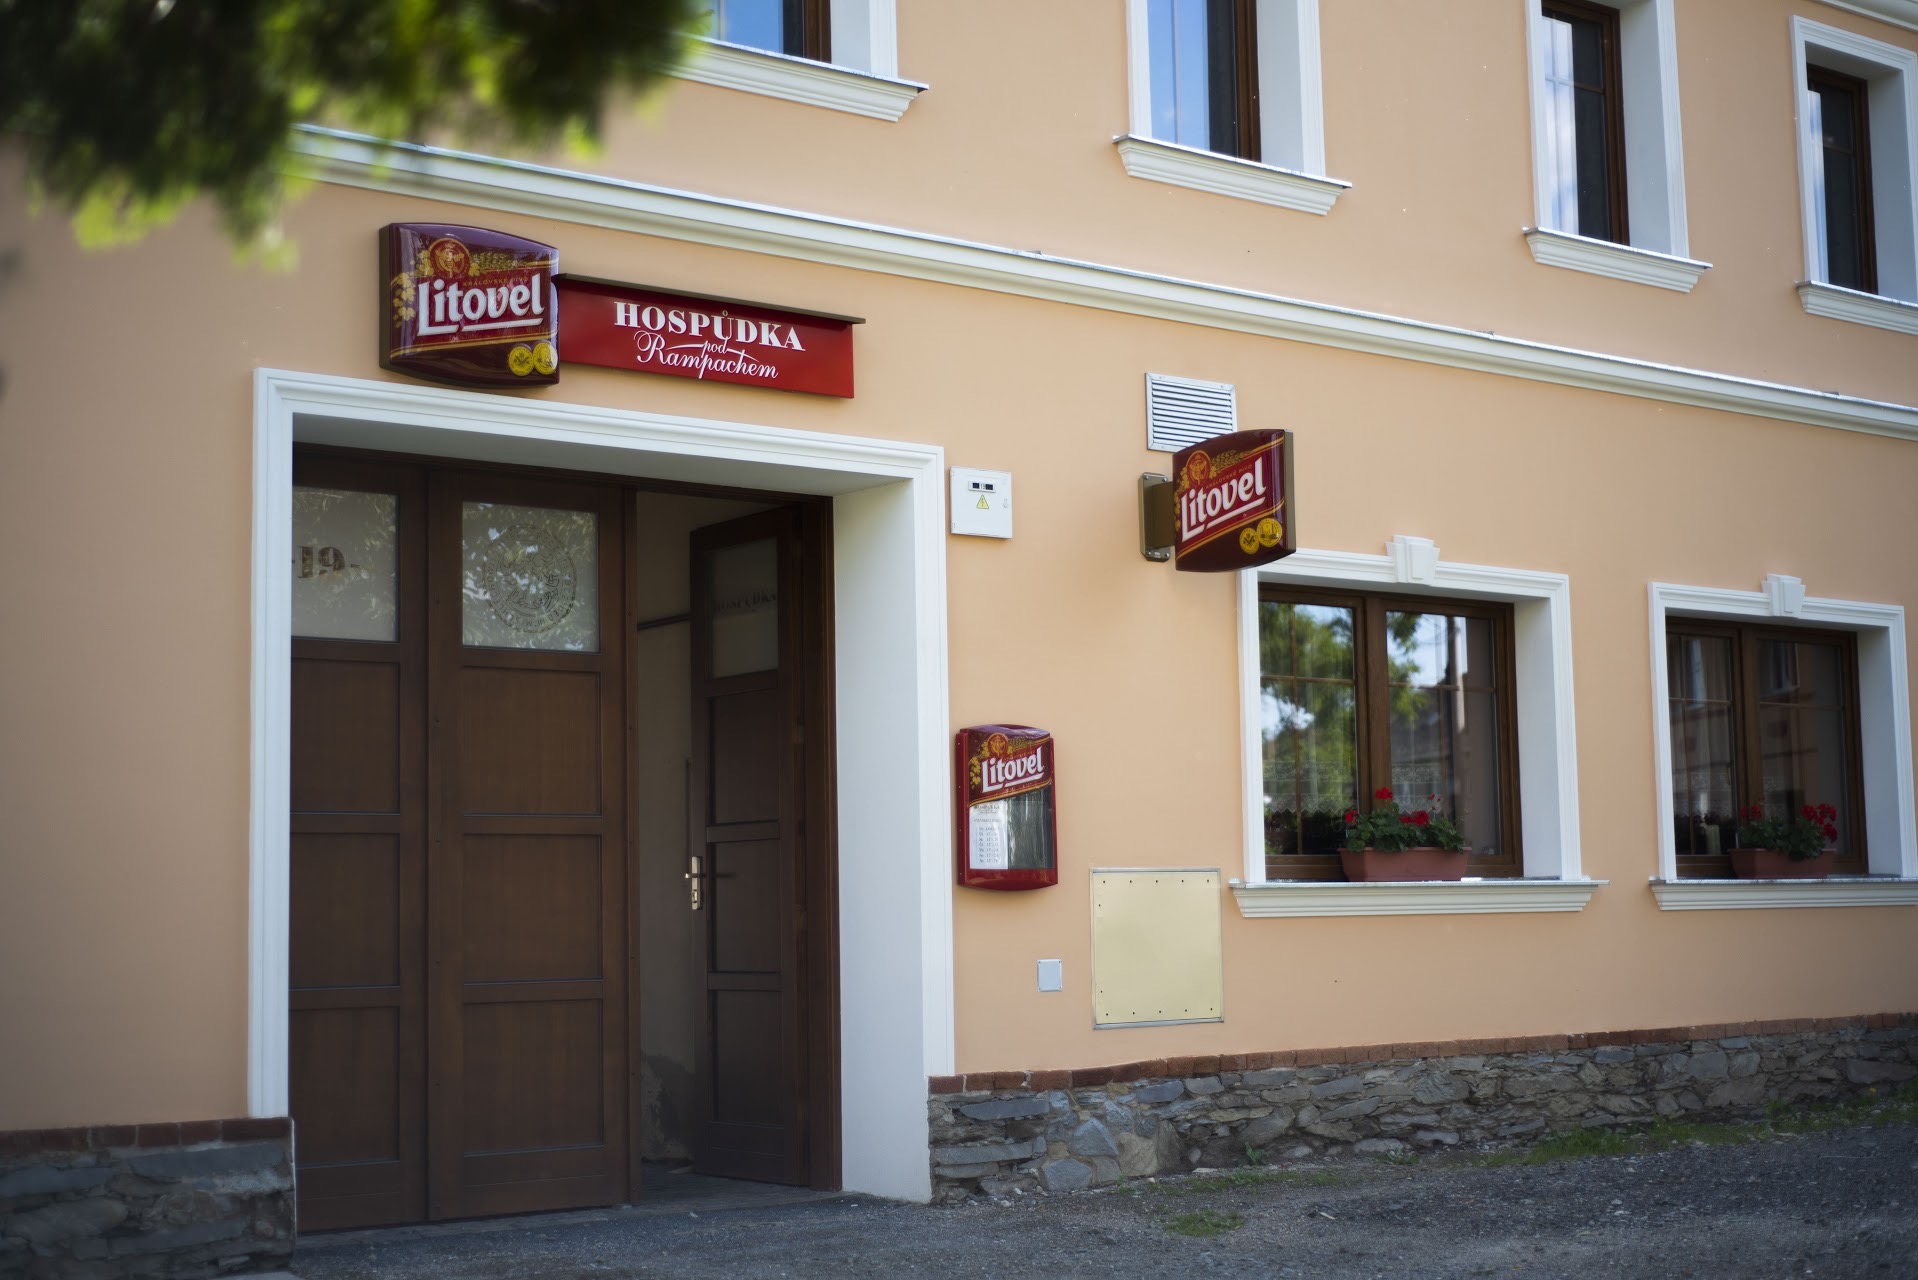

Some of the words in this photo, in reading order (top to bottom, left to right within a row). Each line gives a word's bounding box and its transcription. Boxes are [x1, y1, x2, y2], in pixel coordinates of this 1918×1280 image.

[417, 272, 545, 337] Litovel
[614, 301, 806, 352] HOSPŮDKA
[633, 330, 779, 380] Rampachem
[701, 337, 729, 359] pod
[1181, 456, 1267, 543] Litovel
[981, 745, 1045, 793] Litovel
